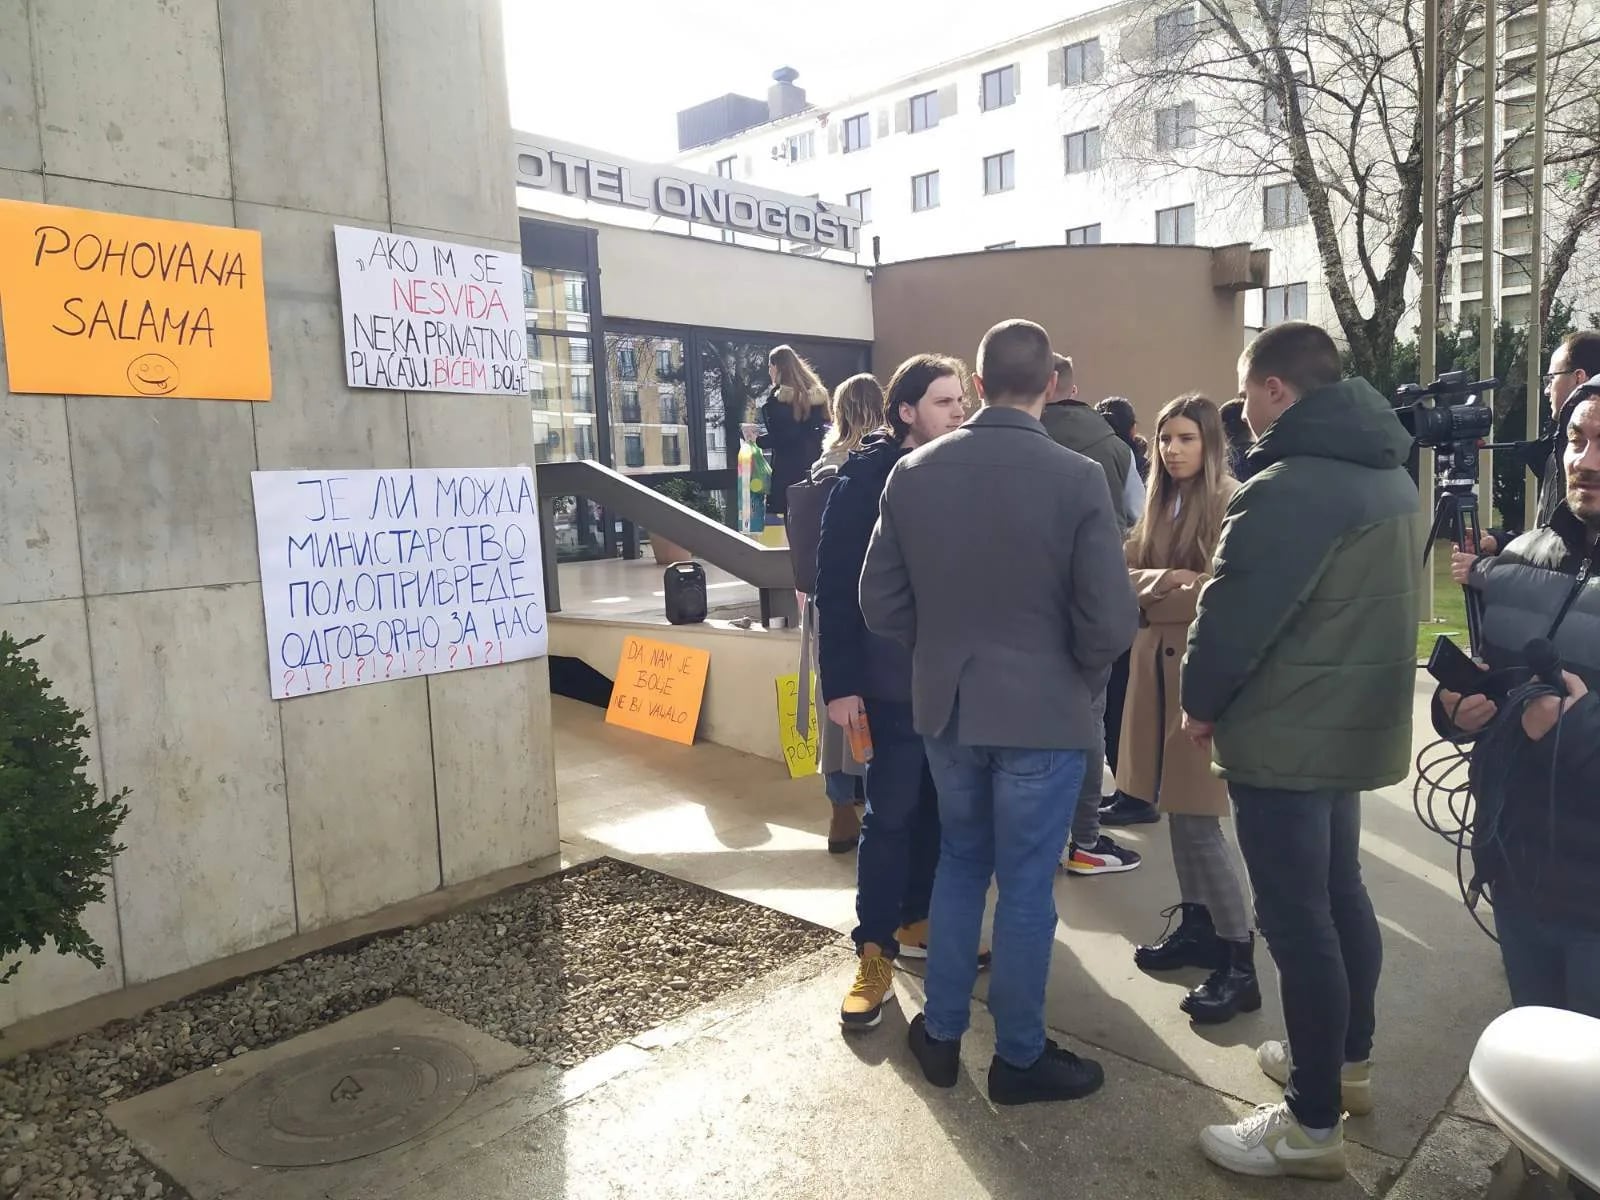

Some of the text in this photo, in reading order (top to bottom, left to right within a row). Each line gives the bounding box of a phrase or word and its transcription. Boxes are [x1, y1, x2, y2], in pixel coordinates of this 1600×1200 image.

[515, 142, 863, 250] OTEL ONOGOŠT
[34, 225, 247, 290] POHOVANA
[432, 245, 457, 278] IM
[470, 253, 503, 285] SE
[51, 297, 215, 348] SALAMA
[353, 312, 421, 356] NEKA
[297, 474, 535, 521] ЈЕ ЛИ МОЖДА
[288, 523, 526, 568] МИНИСТАРСТВО
[288, 560, 535, 618] ПОЉОПРИВРЕДЕ
[281, 602, 543, 669] ОДГОВОРНО ЗА НАС
[627, 640, 645, 664] DA
[650, 647, 673, 671] NAM
[629, 696, 642, 712] BI
